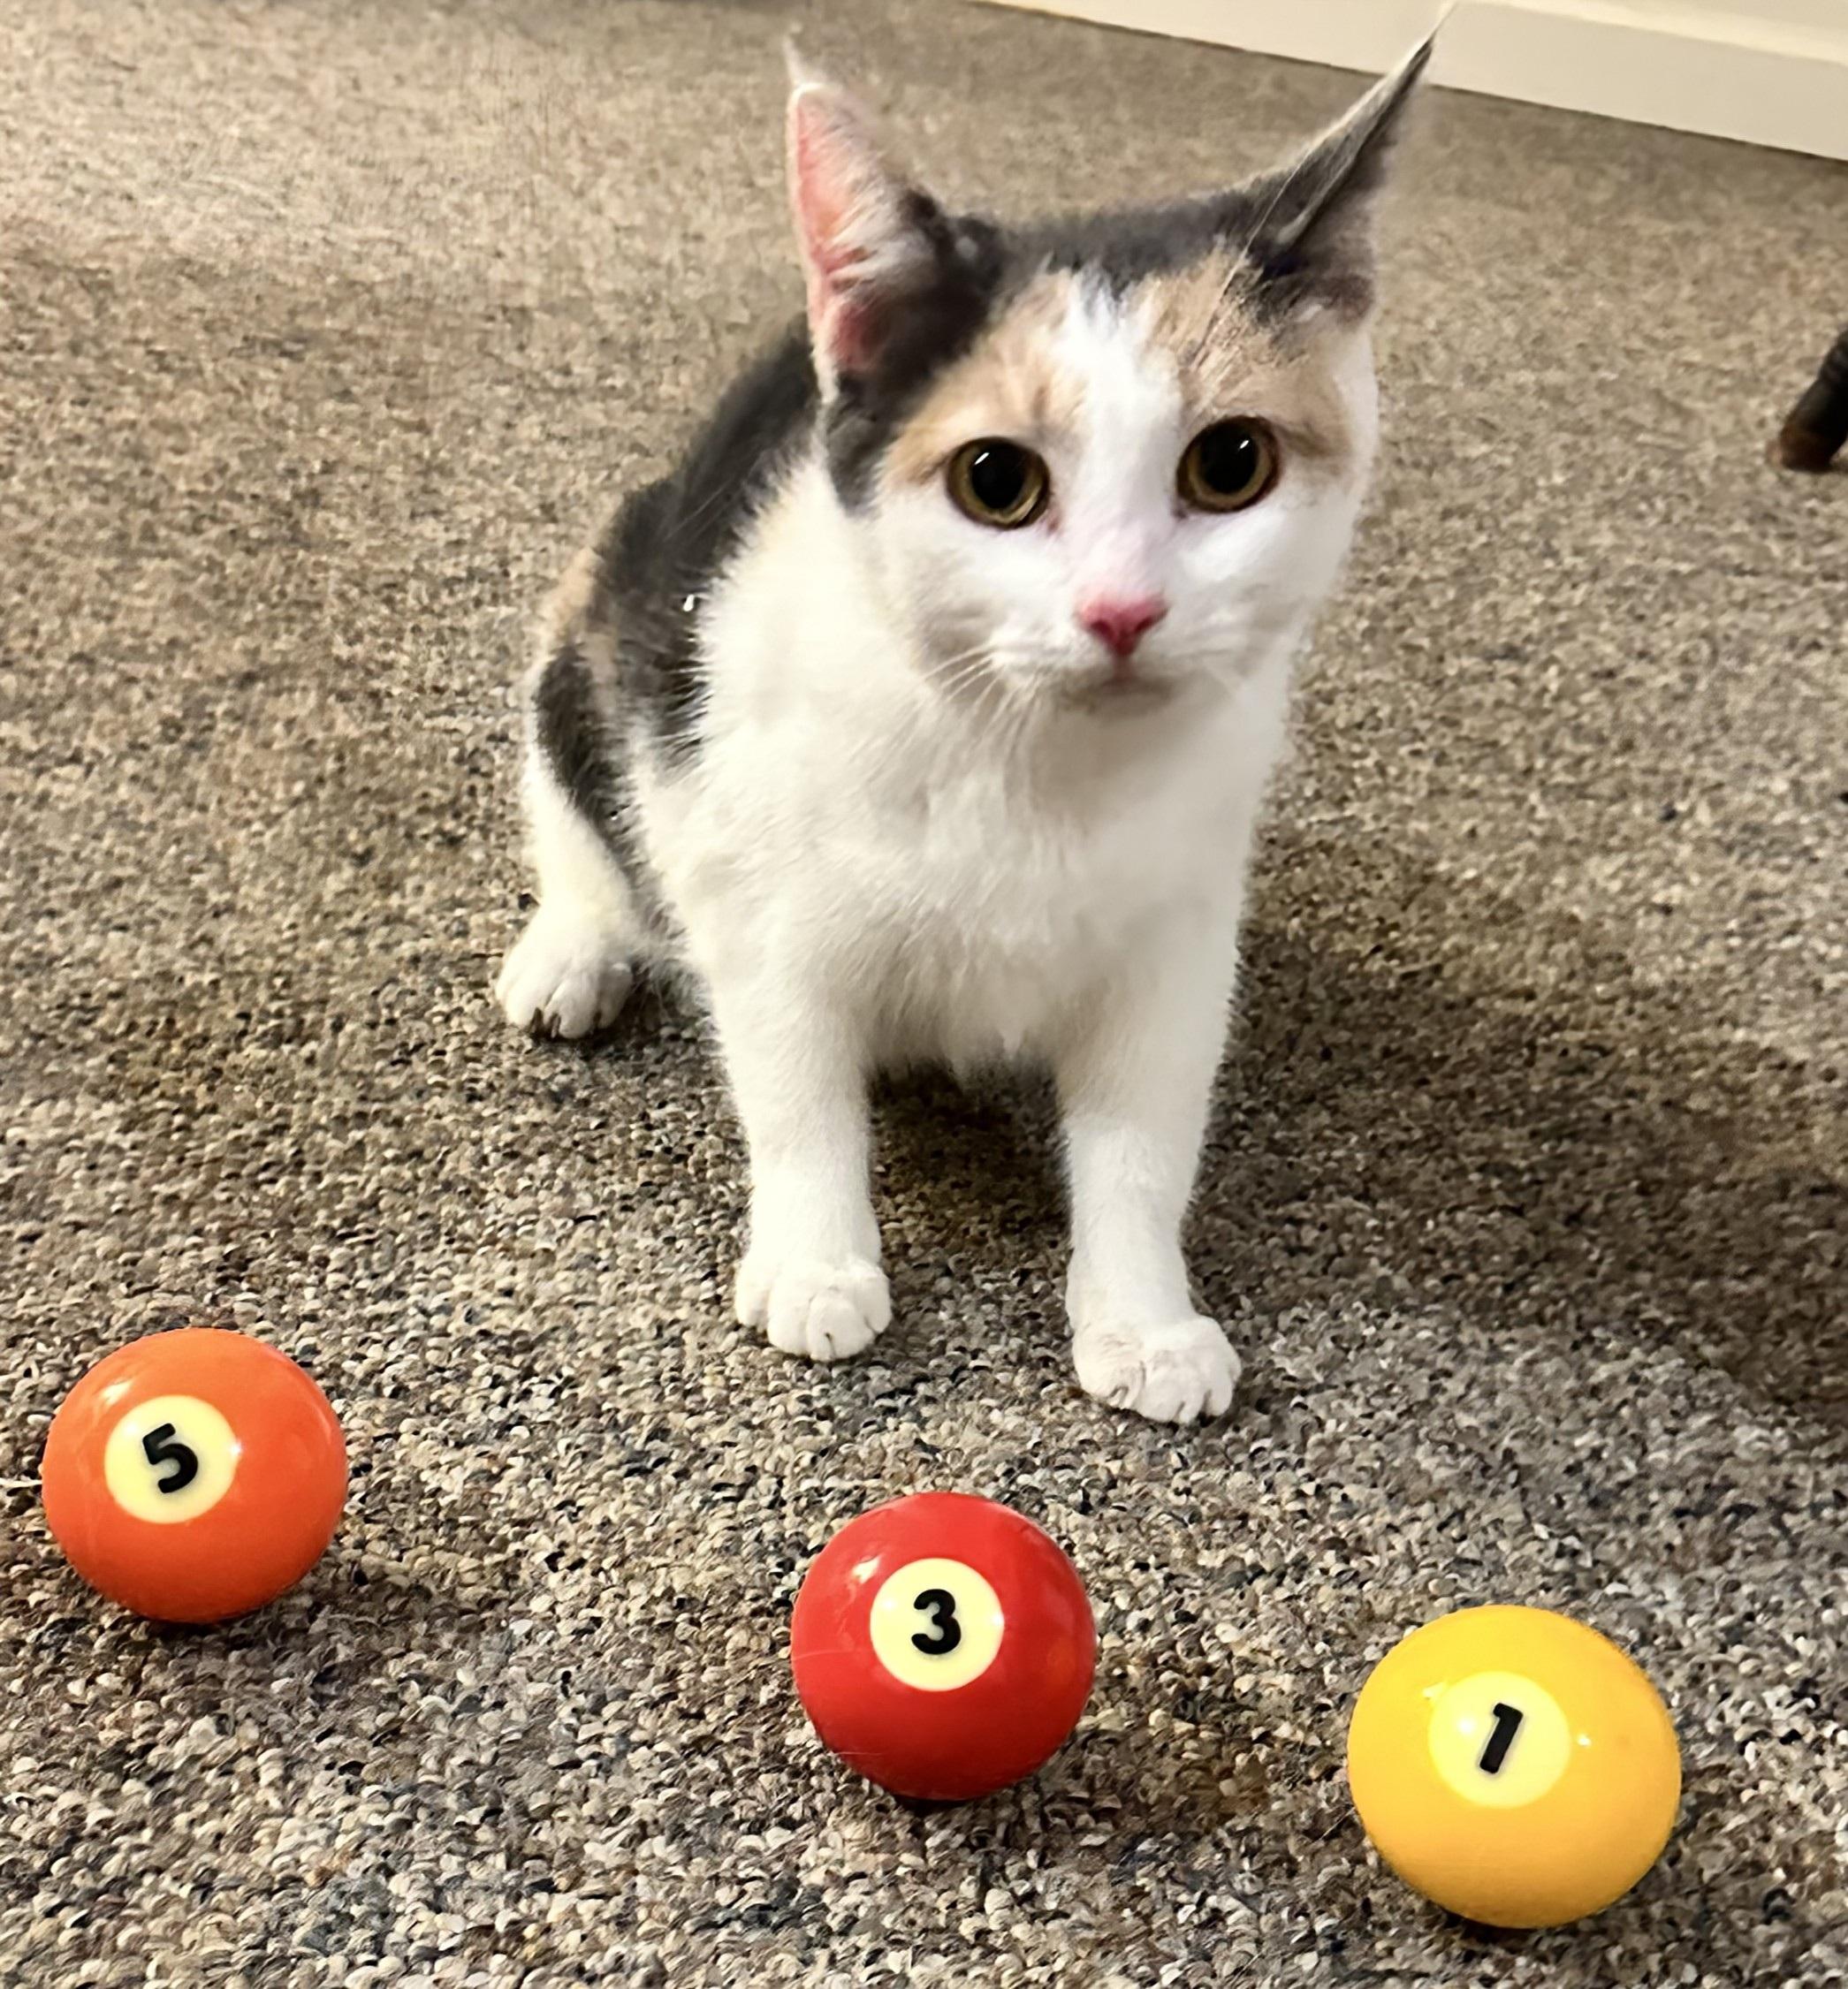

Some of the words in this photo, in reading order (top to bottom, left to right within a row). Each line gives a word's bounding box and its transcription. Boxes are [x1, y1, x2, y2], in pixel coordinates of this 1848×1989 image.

[141, 1422, 200, 1495] 5
[910, 1588, 962, 1657] 3
[1479, 1702, 1525, 1775] 1
